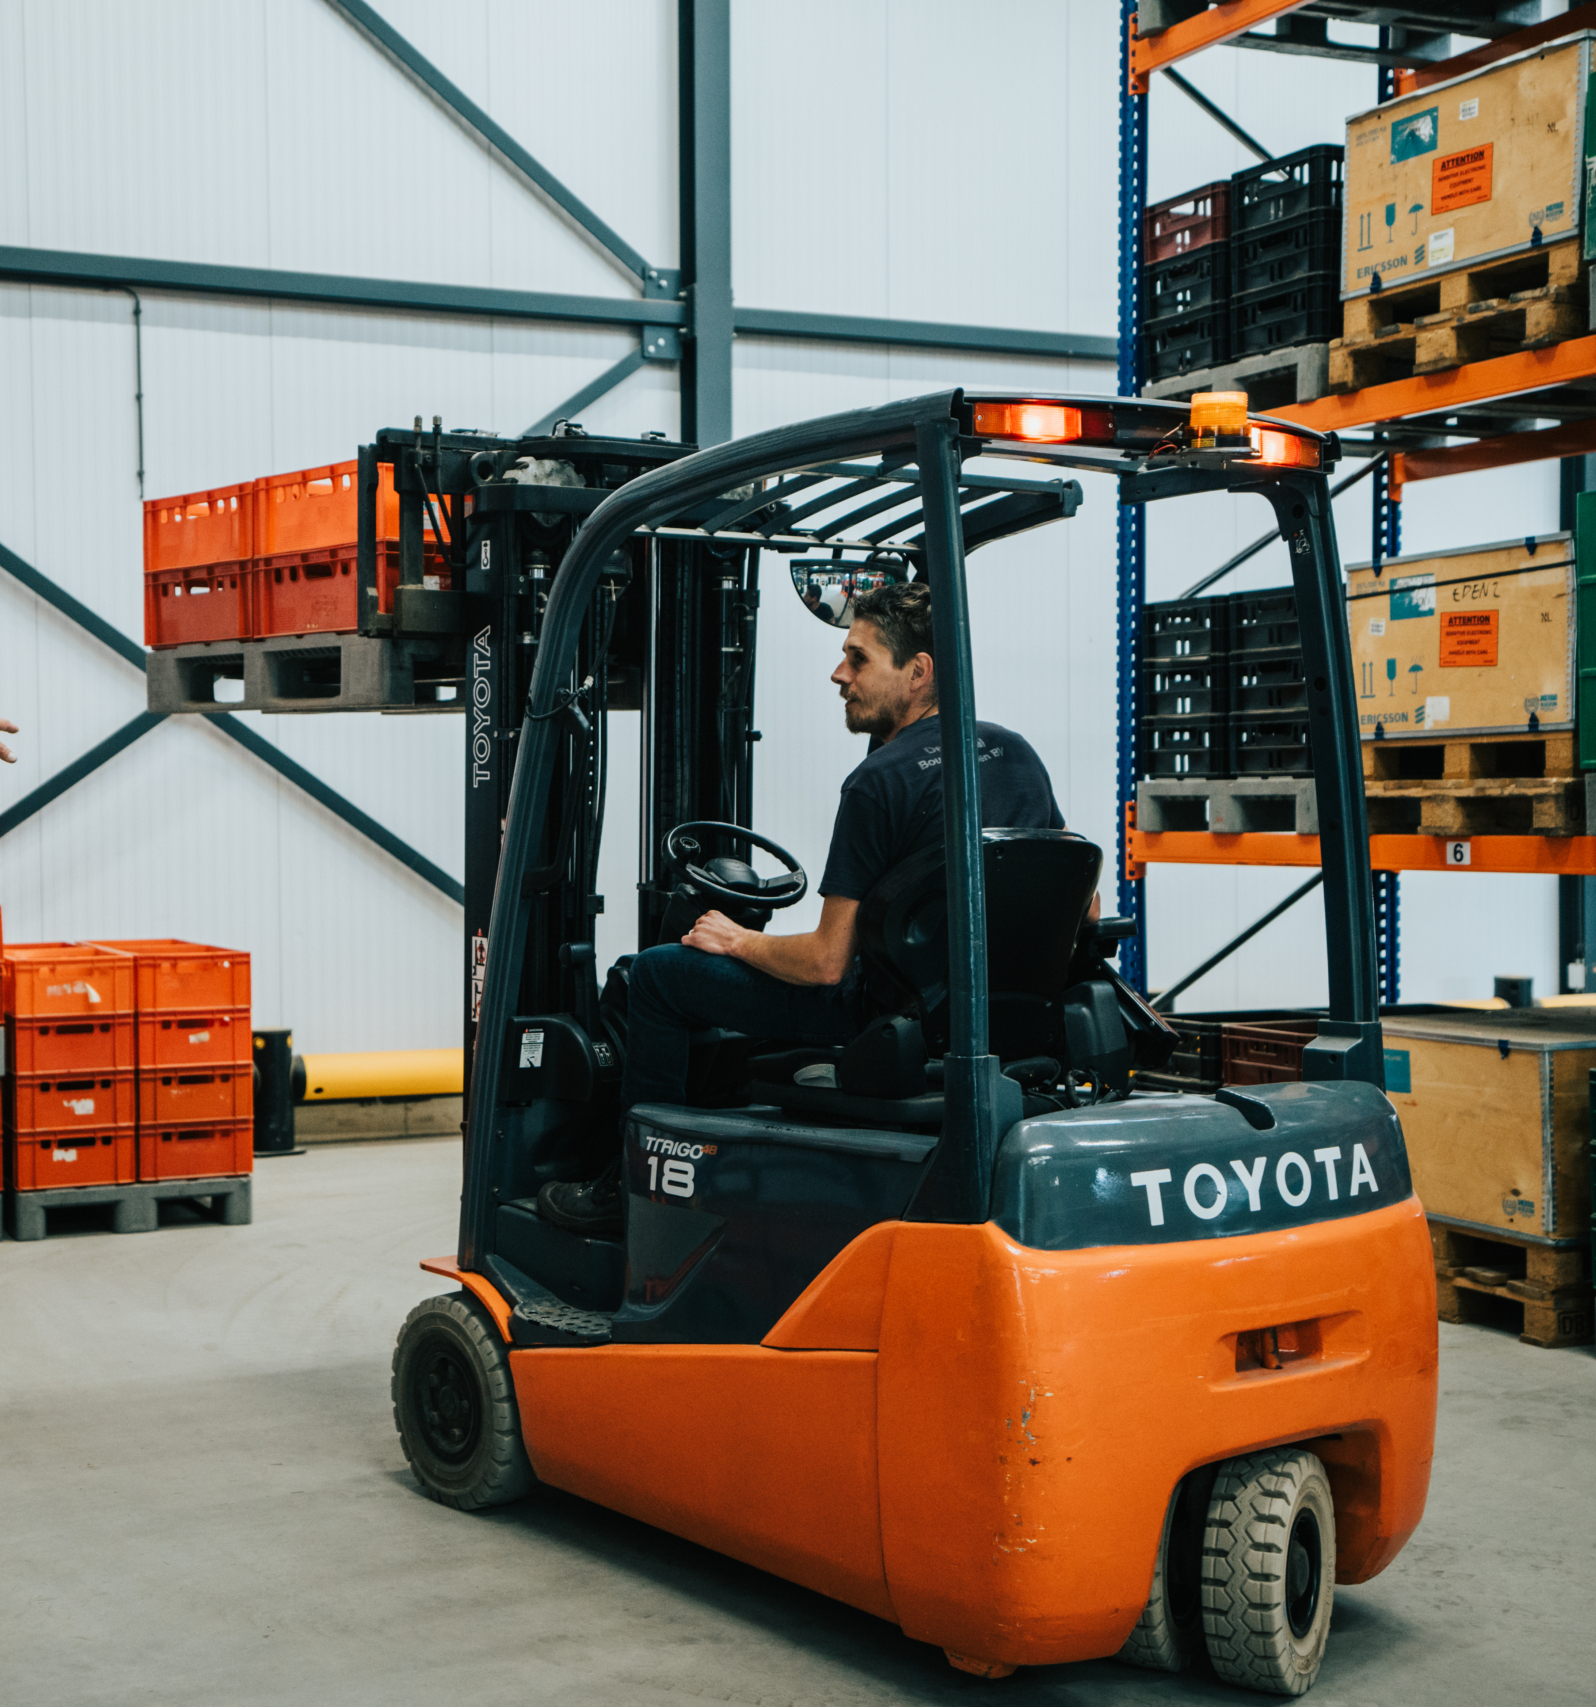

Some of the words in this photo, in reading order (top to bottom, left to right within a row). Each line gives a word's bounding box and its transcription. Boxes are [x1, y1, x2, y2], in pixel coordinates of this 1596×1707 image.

[1441, 150, 1484, 170] ATTENTION
[1357, 255, 1408, 279] ERICSSON
[1448, 615, 1490, 626] ATTENTION
[1541, 612, 1553, 624] NL
[473, 624, 492, 788] TOYOTA
[1361, 712, 1409, 725] ERICSSON
[1453, 843, 1464, 863] 6
[647, 1156, 695, 1199] 18
[1130, 1143, 1379, 1227] TOYOTA
